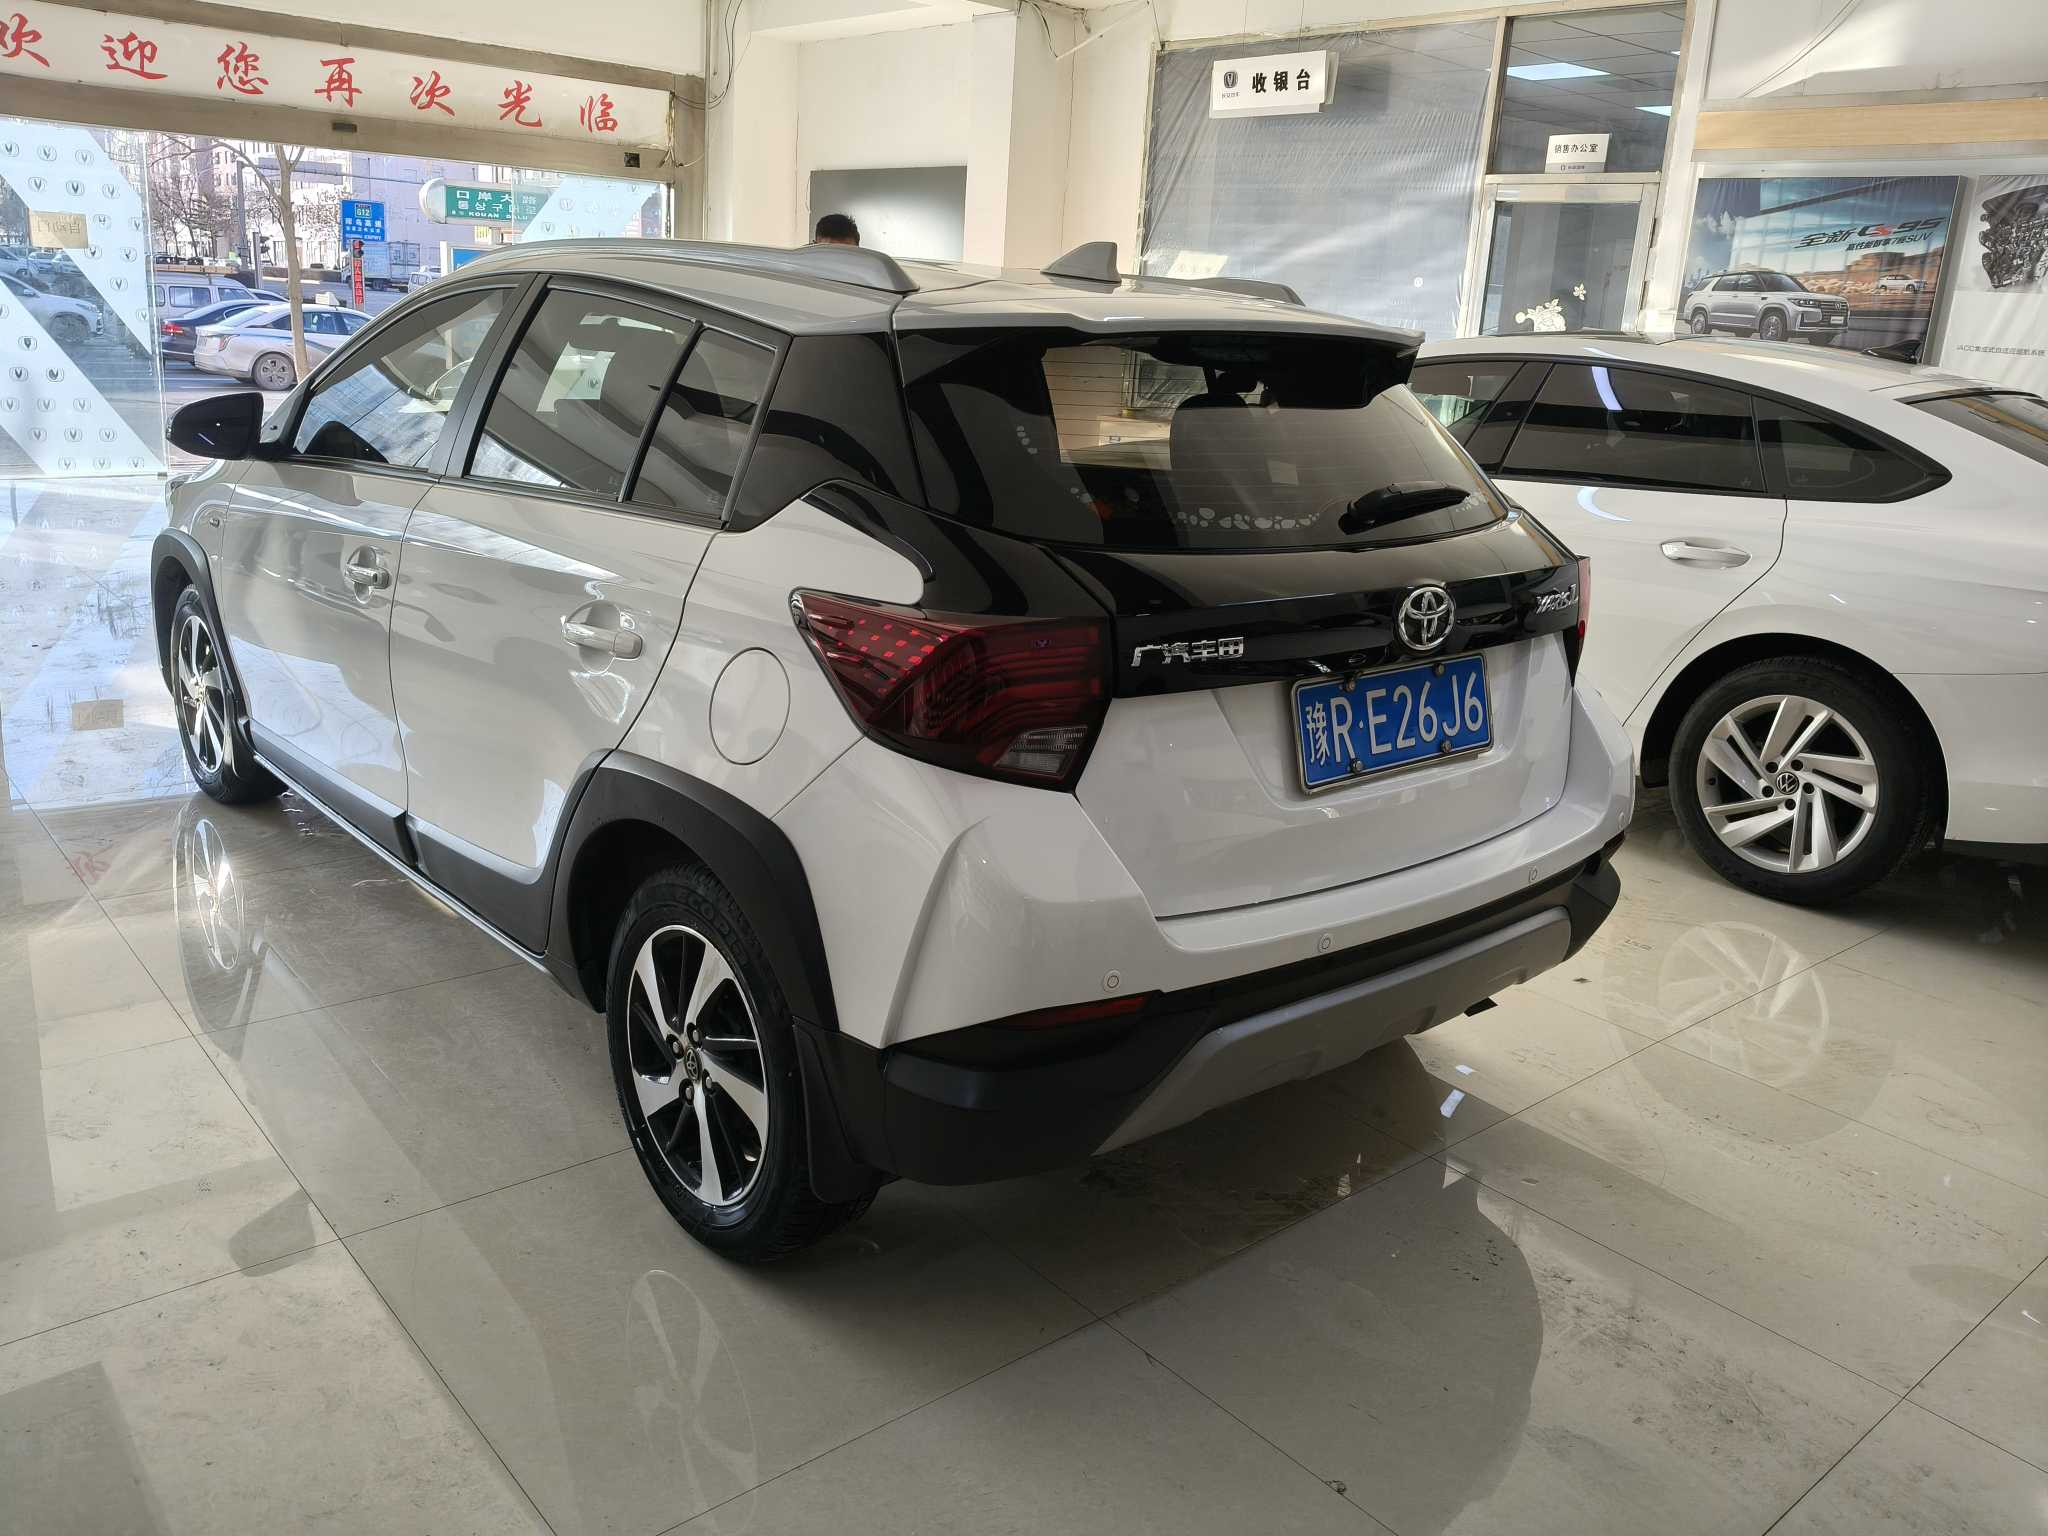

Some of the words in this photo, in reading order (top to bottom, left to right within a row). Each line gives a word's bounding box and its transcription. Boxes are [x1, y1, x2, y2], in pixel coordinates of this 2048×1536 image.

[0, 13, 618, 133] 欢迎您再次光临
[1252, 69, 1310, 93] 收银台
[1555, 143, 1599, 153] 销售办公室
[468, 211, 500, 219] KOUAN
[1131, 636, 1244, 667] 广汽丰田
